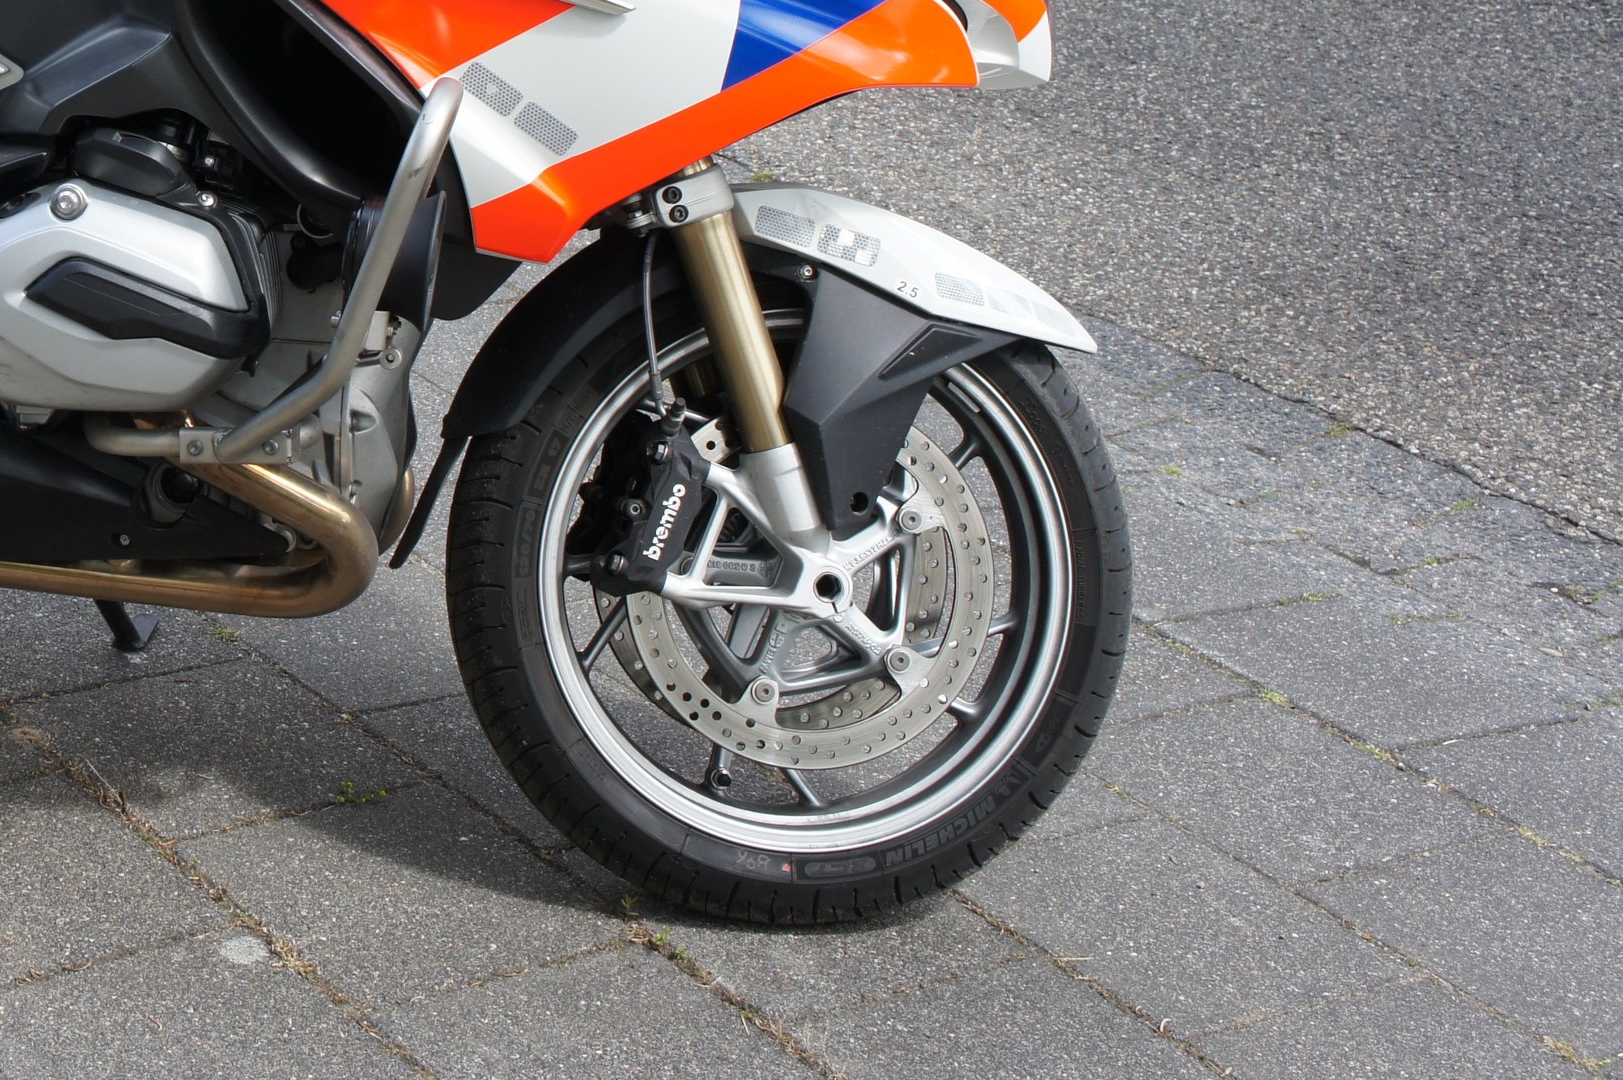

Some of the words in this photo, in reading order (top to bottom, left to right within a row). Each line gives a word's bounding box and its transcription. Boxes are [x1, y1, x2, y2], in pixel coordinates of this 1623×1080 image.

[897, 281, 920, 298] 2.5
[643, 483, 686, 561] brembo
[885, 798, 997, 867] MICHELIN
